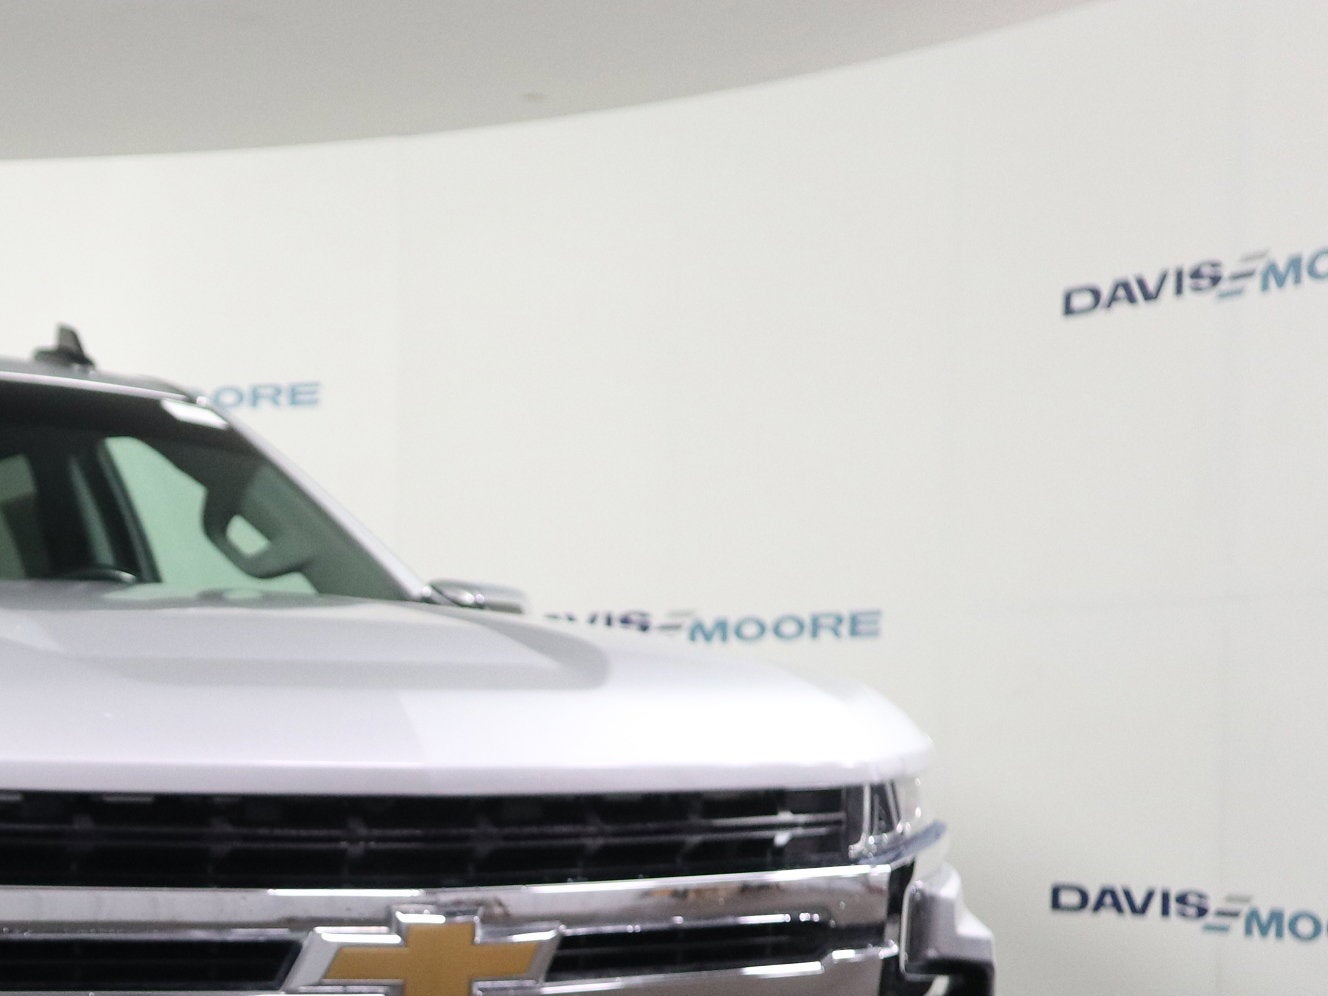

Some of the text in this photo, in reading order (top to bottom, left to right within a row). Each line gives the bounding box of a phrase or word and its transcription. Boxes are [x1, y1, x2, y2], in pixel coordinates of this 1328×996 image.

[1061, 258, 1223, 318] DAVIS
[686, 609, 881, 645] MOORE
[1049, 882, 1210, 920] DAVIS
